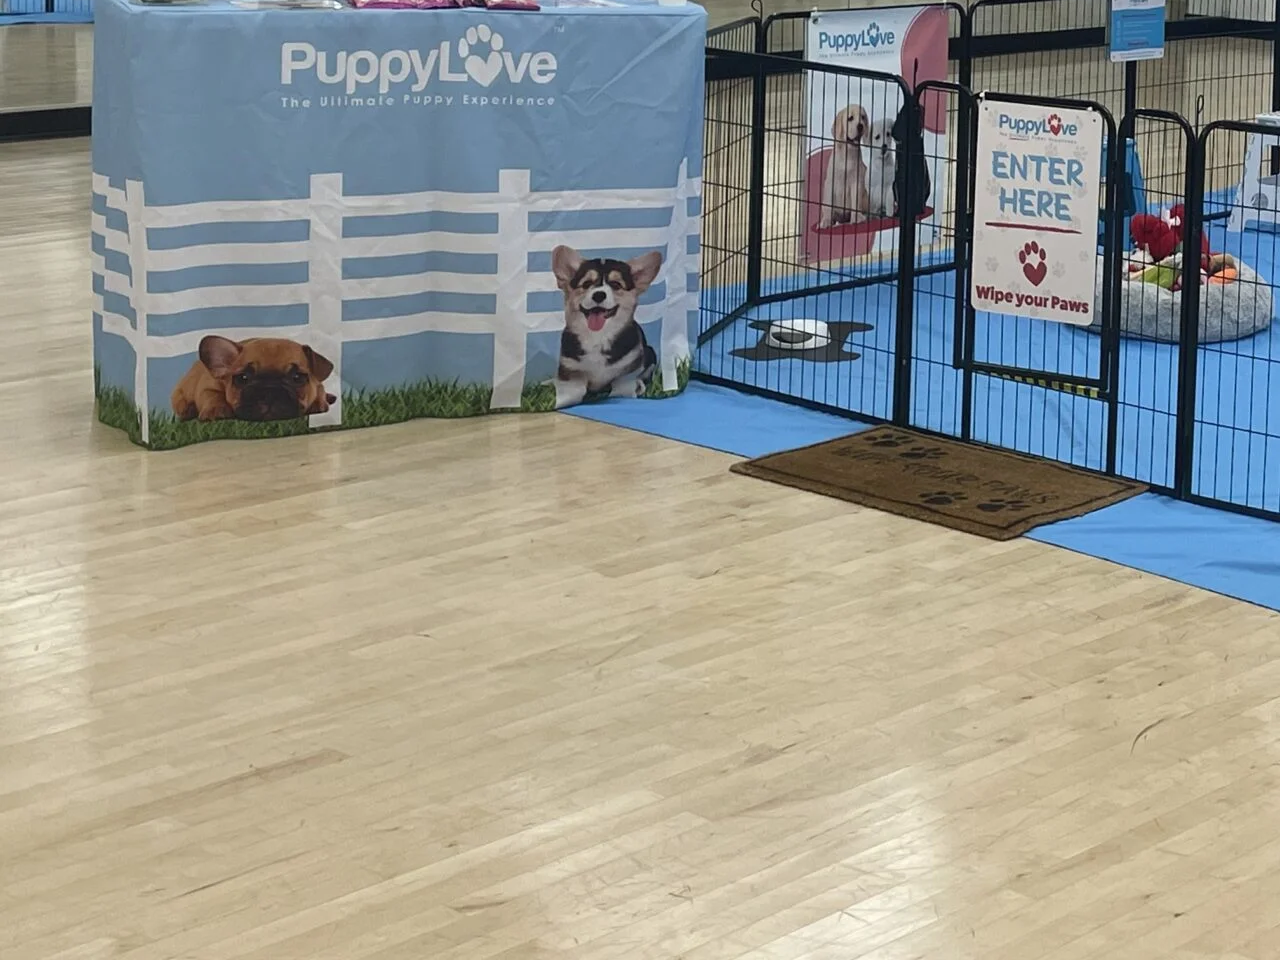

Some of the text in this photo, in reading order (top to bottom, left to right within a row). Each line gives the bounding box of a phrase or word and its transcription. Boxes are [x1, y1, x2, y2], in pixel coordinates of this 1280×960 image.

[819, 22, 895, 52] PuppyLove
[281, 23, 558, 94] PuppyLove
[281, 94, 556, 108] The Ultimate Puppy Experience
[999, 113, 1078, 137] PuppyLove
[992, 151, 1084, 187] ENTER
[999, 187, 1073, 222] HERE
[975, 285, 1089, 314] Wipe your Paws
